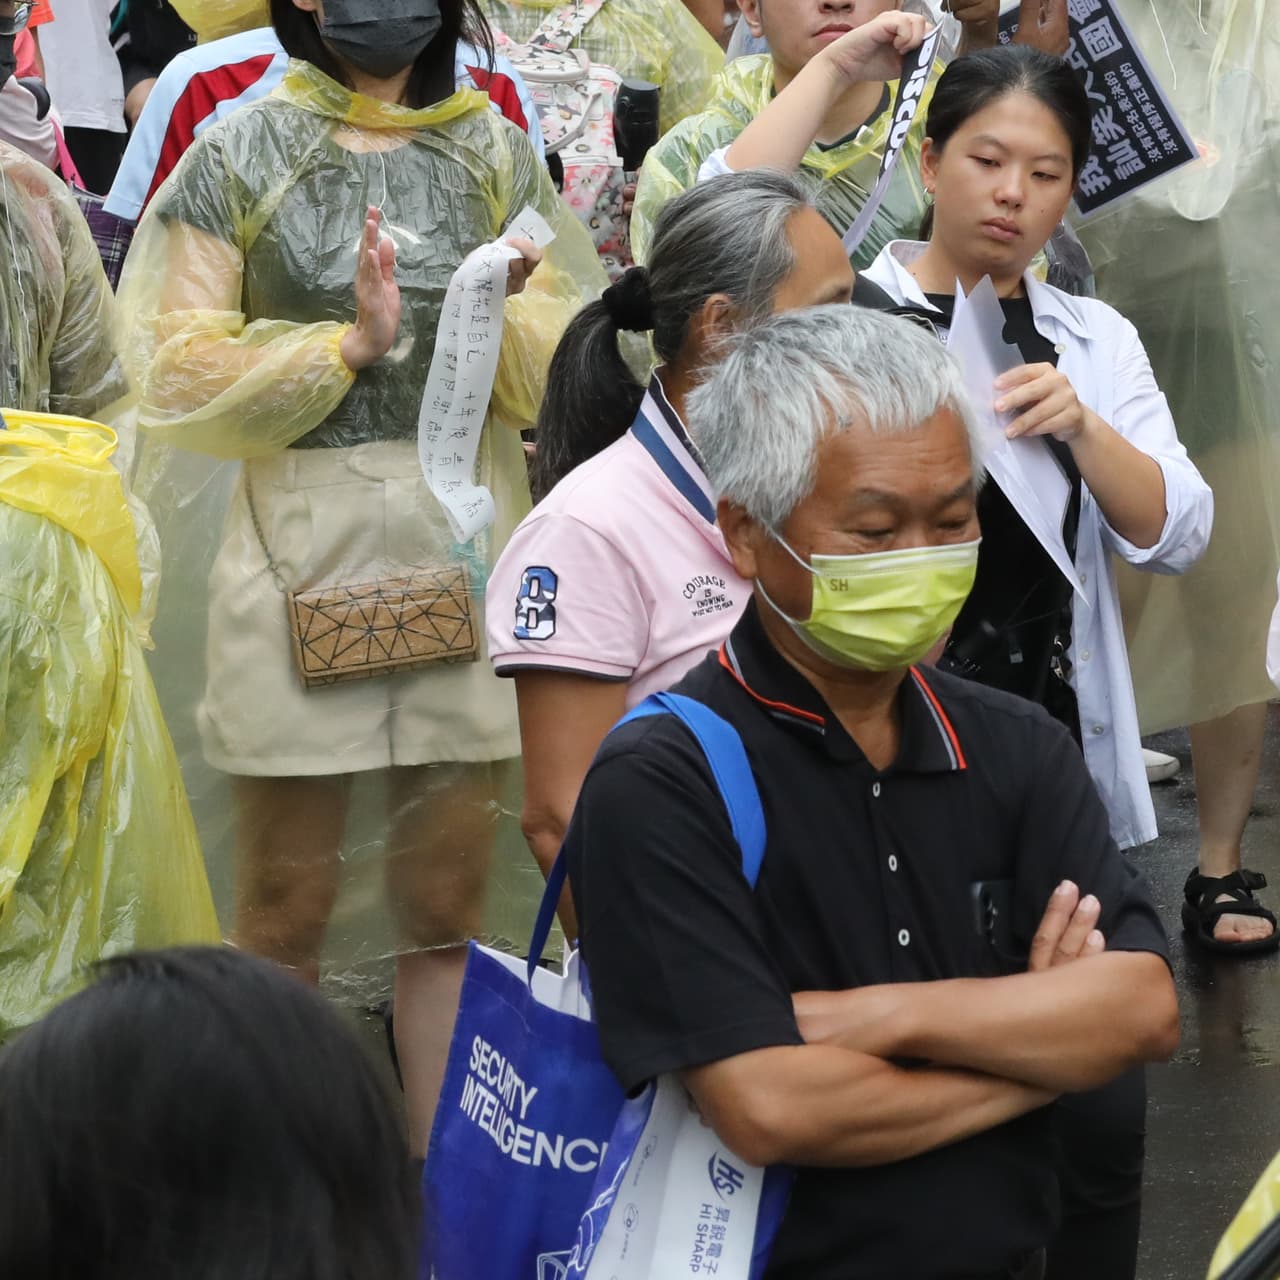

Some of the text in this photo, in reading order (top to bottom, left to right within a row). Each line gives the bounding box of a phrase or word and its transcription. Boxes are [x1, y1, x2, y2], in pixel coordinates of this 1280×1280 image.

[1103, 70, 1164, 164] 沒有記名表決的
[1119, 61, 1179, 155] 沒有程序正義的
[682, 575, 726, 600] COURAGE
[696, 594, 726, 609] KNOWING
[830, 579, 848, 591] SH
[470, 1035, 538, 1120] SECURITY
[460, 1074, 609, 1173] INTELLIGENC
[691, 1203, 713, 1273] HI SHARP
